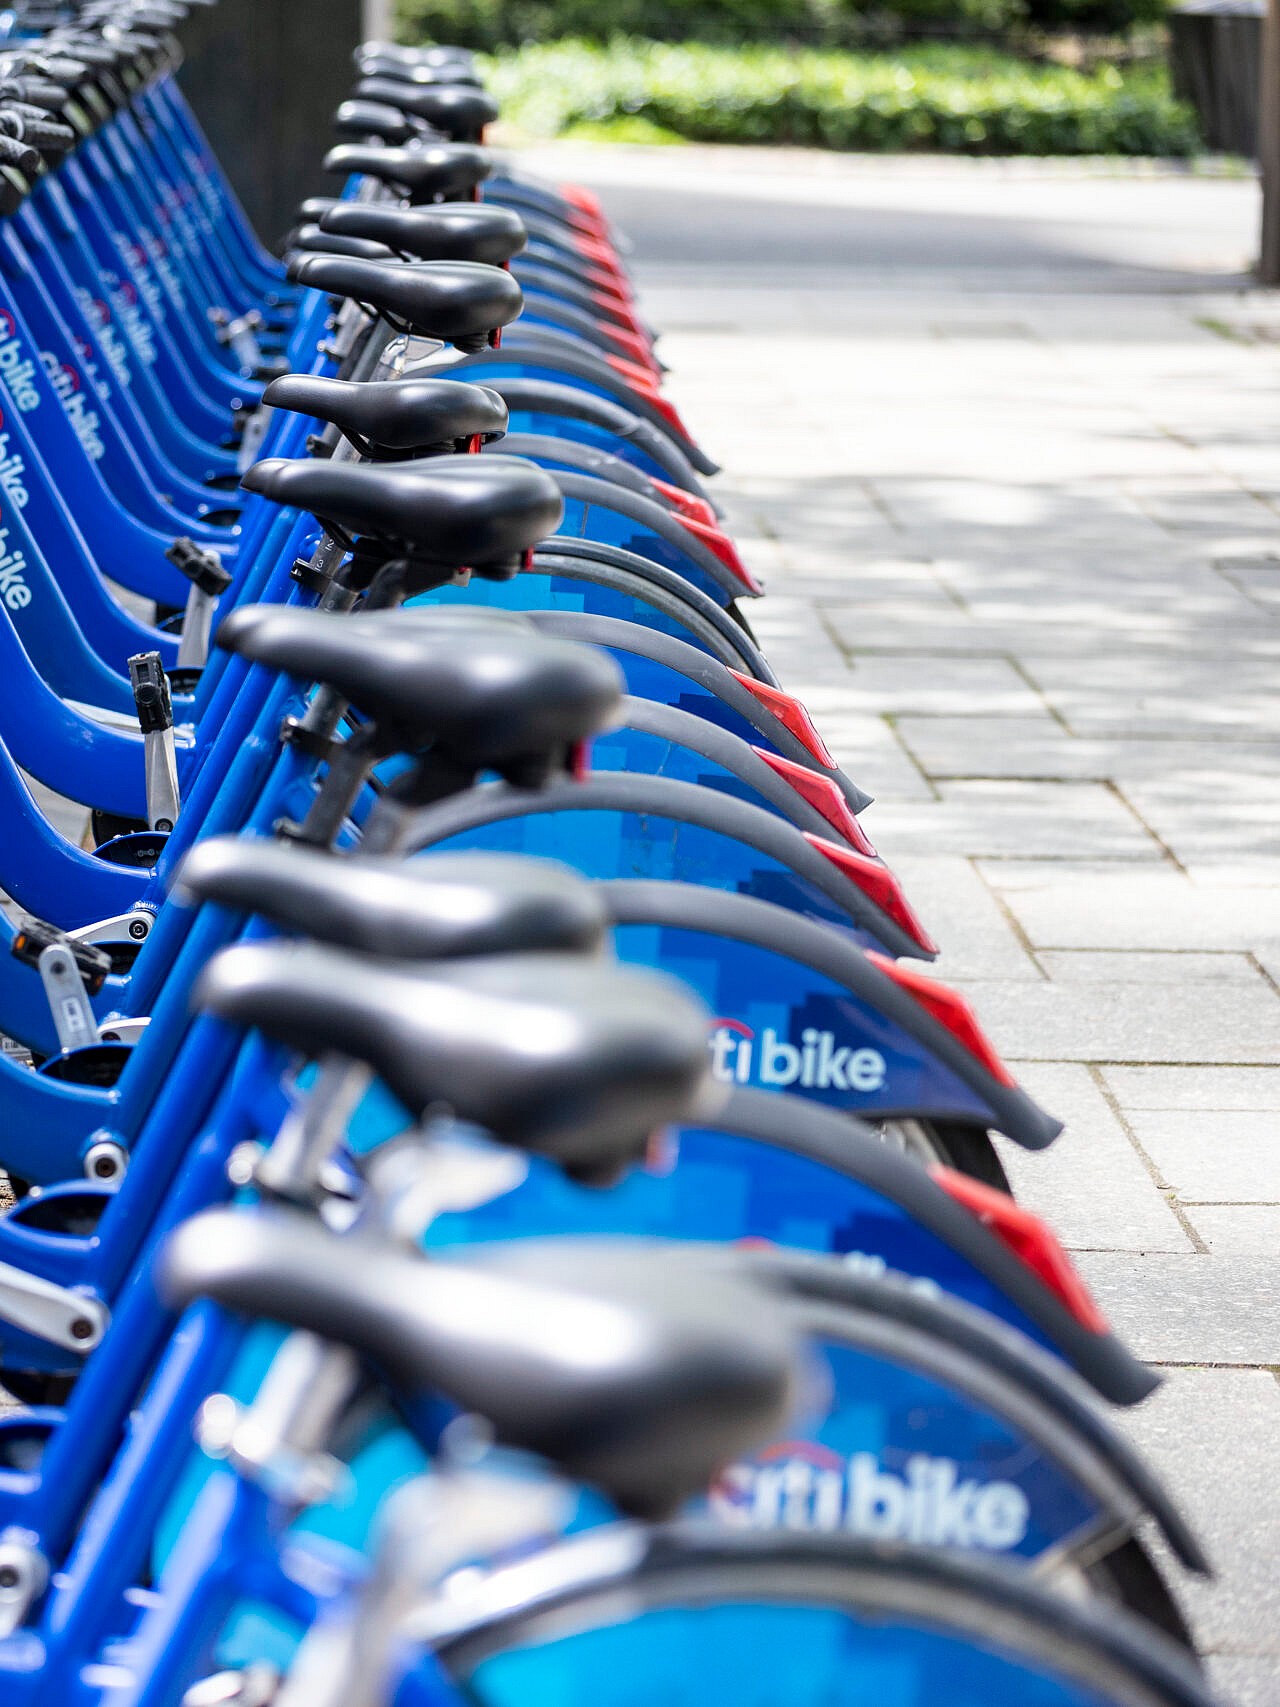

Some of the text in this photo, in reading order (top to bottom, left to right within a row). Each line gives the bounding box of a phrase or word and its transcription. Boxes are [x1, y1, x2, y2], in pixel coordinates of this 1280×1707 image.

[707, 1017, 886, 1092] ti bike
[846, 1453, 1030, 1547] bike
